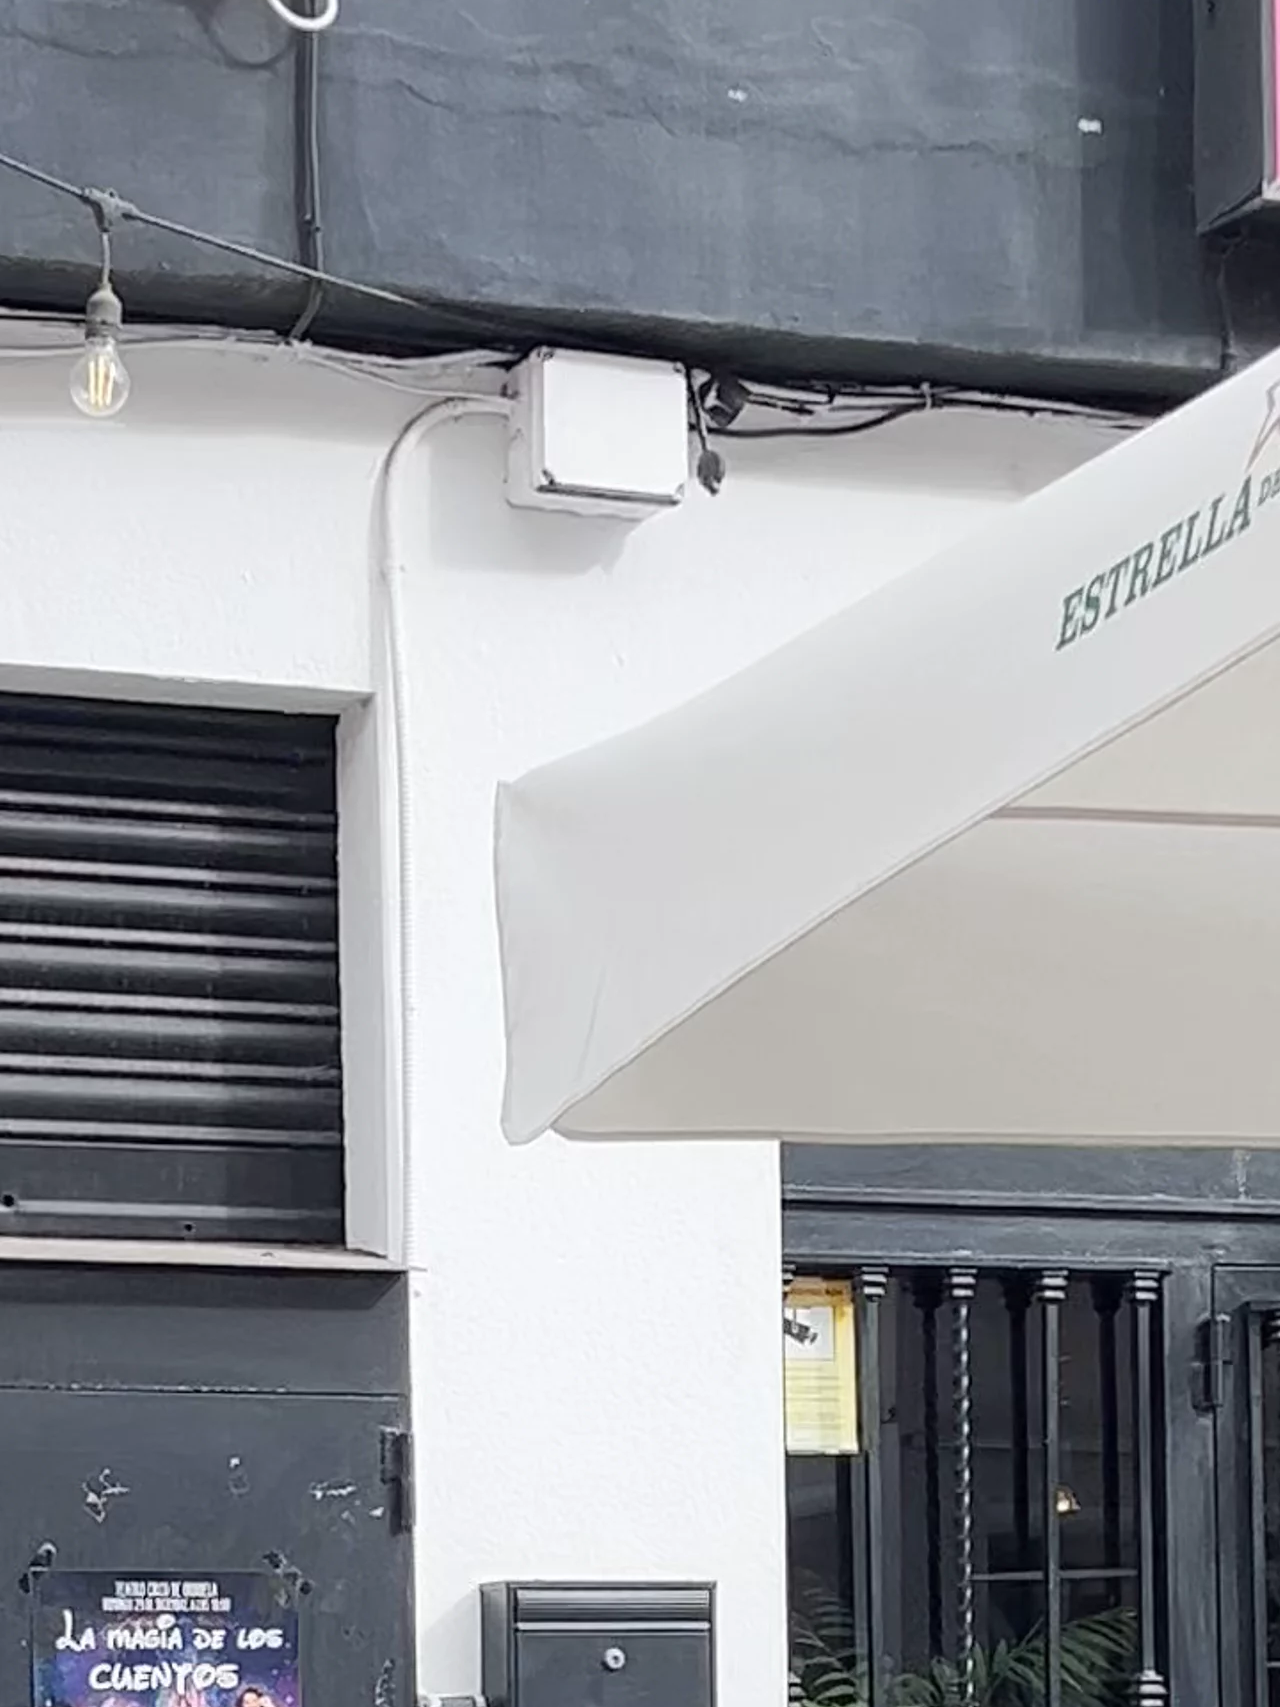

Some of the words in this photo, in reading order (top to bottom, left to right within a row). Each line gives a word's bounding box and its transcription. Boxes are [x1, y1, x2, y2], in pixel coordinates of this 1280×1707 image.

[1055, 473, 1253, 652] ESTRELLA
[192, 1628, 226, 1649] DE
[236, 1627, 284, 1650] LOS
[88, 1661, 239, 1695] CUENTOS
